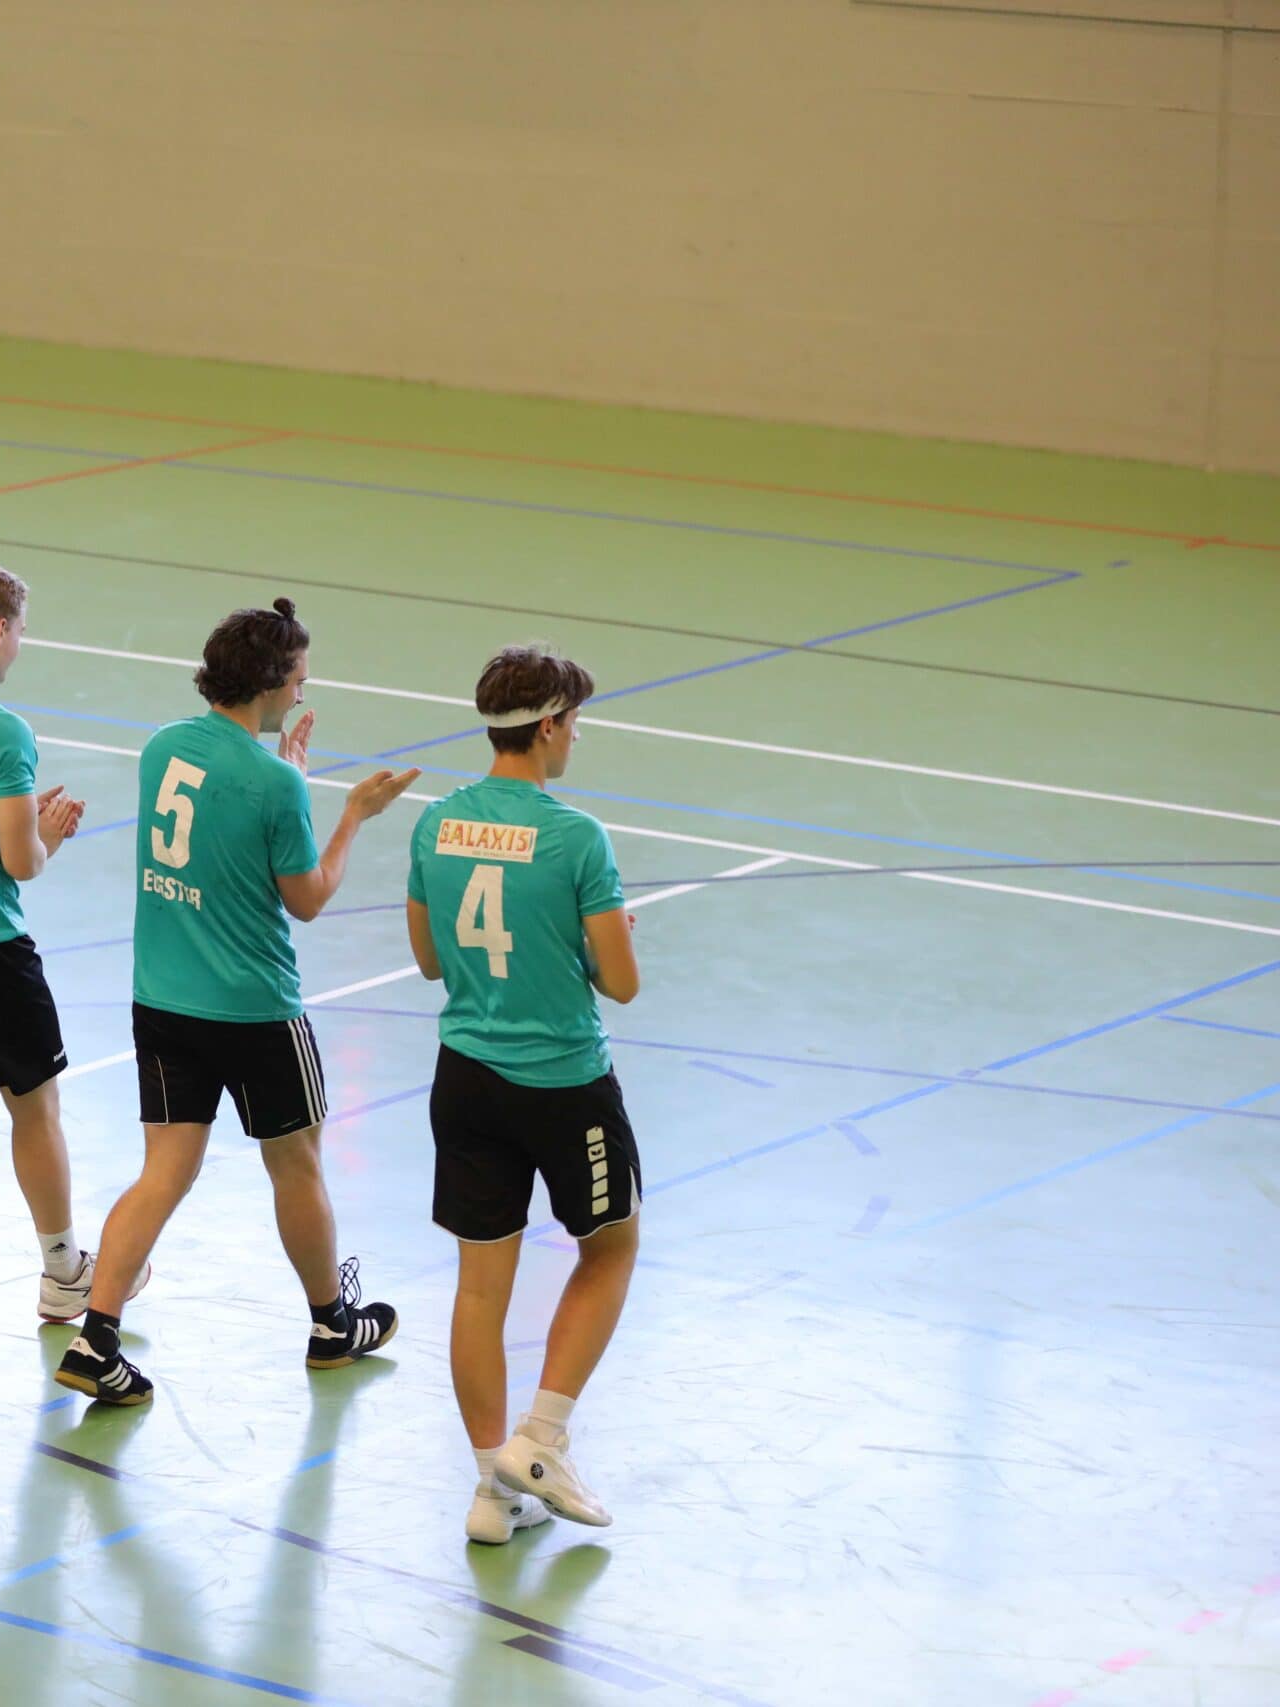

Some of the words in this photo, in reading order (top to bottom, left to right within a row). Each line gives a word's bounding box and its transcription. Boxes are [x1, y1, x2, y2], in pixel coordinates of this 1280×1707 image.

[151, 756, 207, 869] 5
[439, 821, 529, 852] GALAXIS
[456, 864, 513, 979] 4
